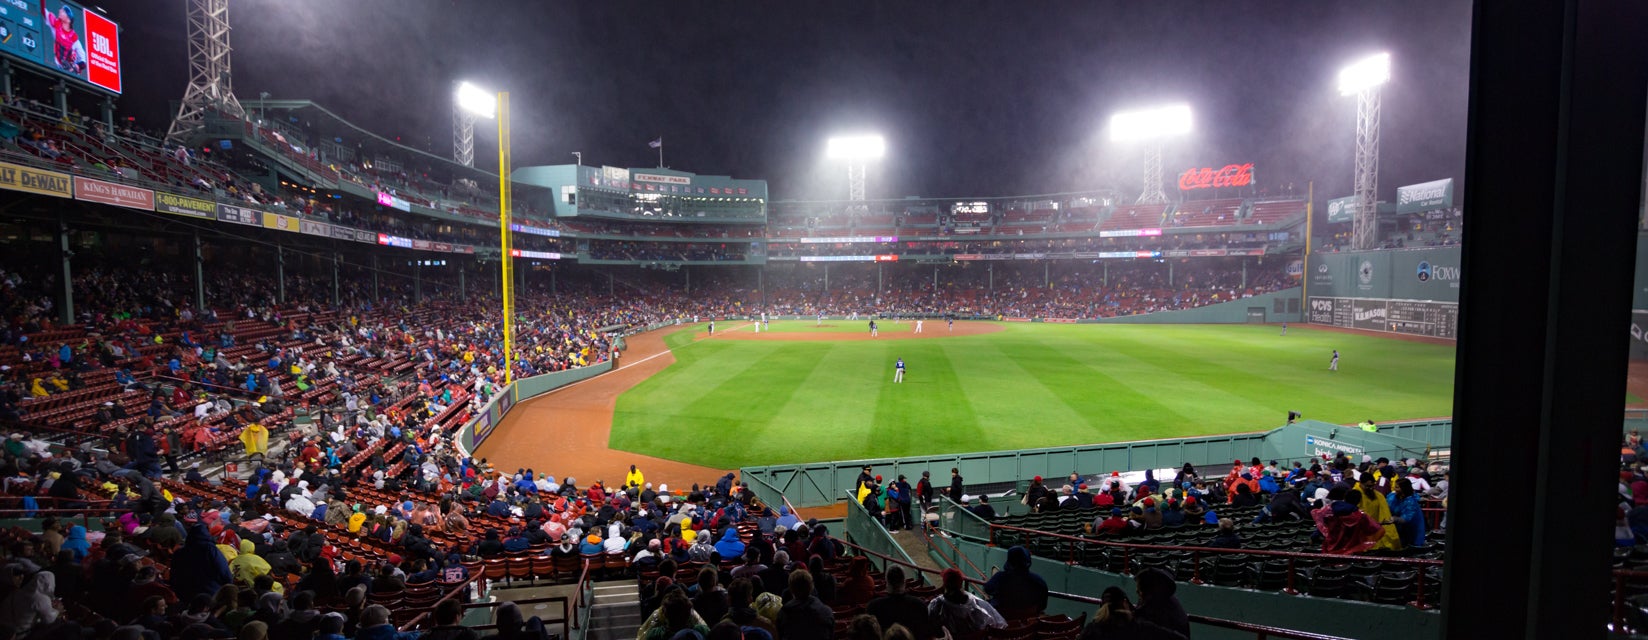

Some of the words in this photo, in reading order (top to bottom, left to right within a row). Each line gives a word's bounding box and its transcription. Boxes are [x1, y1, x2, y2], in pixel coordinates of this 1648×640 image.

[92, 31, 114, 58] JBL
[638, 174, 666, 182] FENWAY
[1179, 163, 1254, 190] Coca-Cola
[83, 182, 110, 195] KING'S
[111, 186, 147, 200] HAWAIIAN
[1409, 186, 1446, 202] National
[158, 194, 214, 212] 1-800-PAVEMENT
[1318, 300, 1333, 312] CVS
[1312, 310, 1332, 323] Health
[1314, 440, 1336, 450] KONICA
